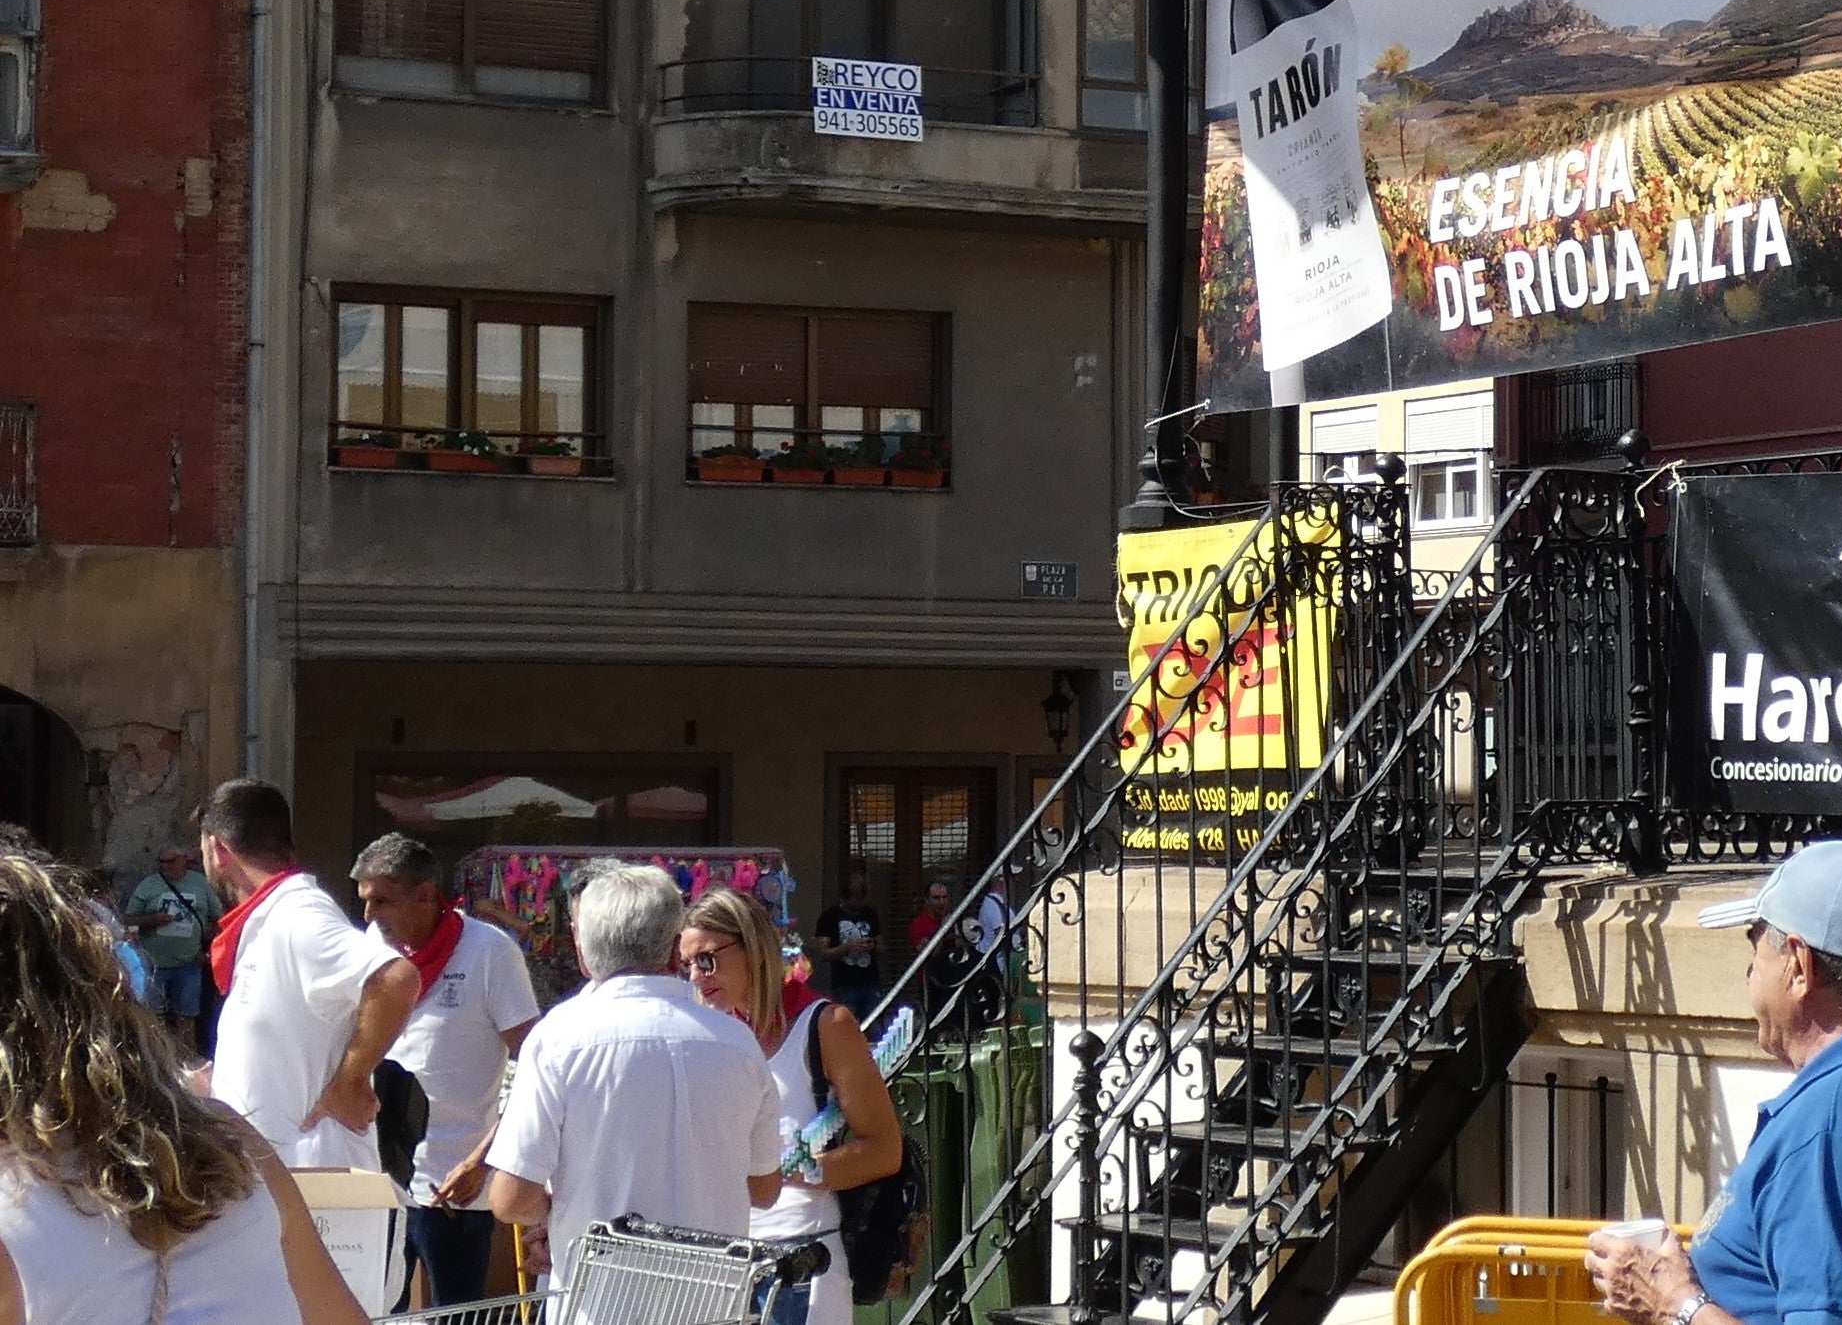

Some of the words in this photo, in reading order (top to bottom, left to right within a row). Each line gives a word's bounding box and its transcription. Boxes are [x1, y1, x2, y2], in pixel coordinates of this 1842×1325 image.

[834, 62, 918, 91] REYCO
[1248, 38, 1342, 139] TARÓN
[816, 88, 845, 108] EN
[851, 91, 920, 114] VENTA
[1428, 138, 1637, 245] ESENCIA
[1304, 255, 1341, 281] RIOJA
[1435, 258, 1495, 334] DE
[1497, 242, 1650, 320] RIOJA
[1667, 197, 1793, 291] ALTA
[1294, 286, 1326, 306] RIOJA
[1328, 272, 1353, 292] ALTA
[1040, 565, 1066, 575] PLAZA
[1710, 756, 1842, 784] Concesionario
[1197, 827, 1226, 851] 128
